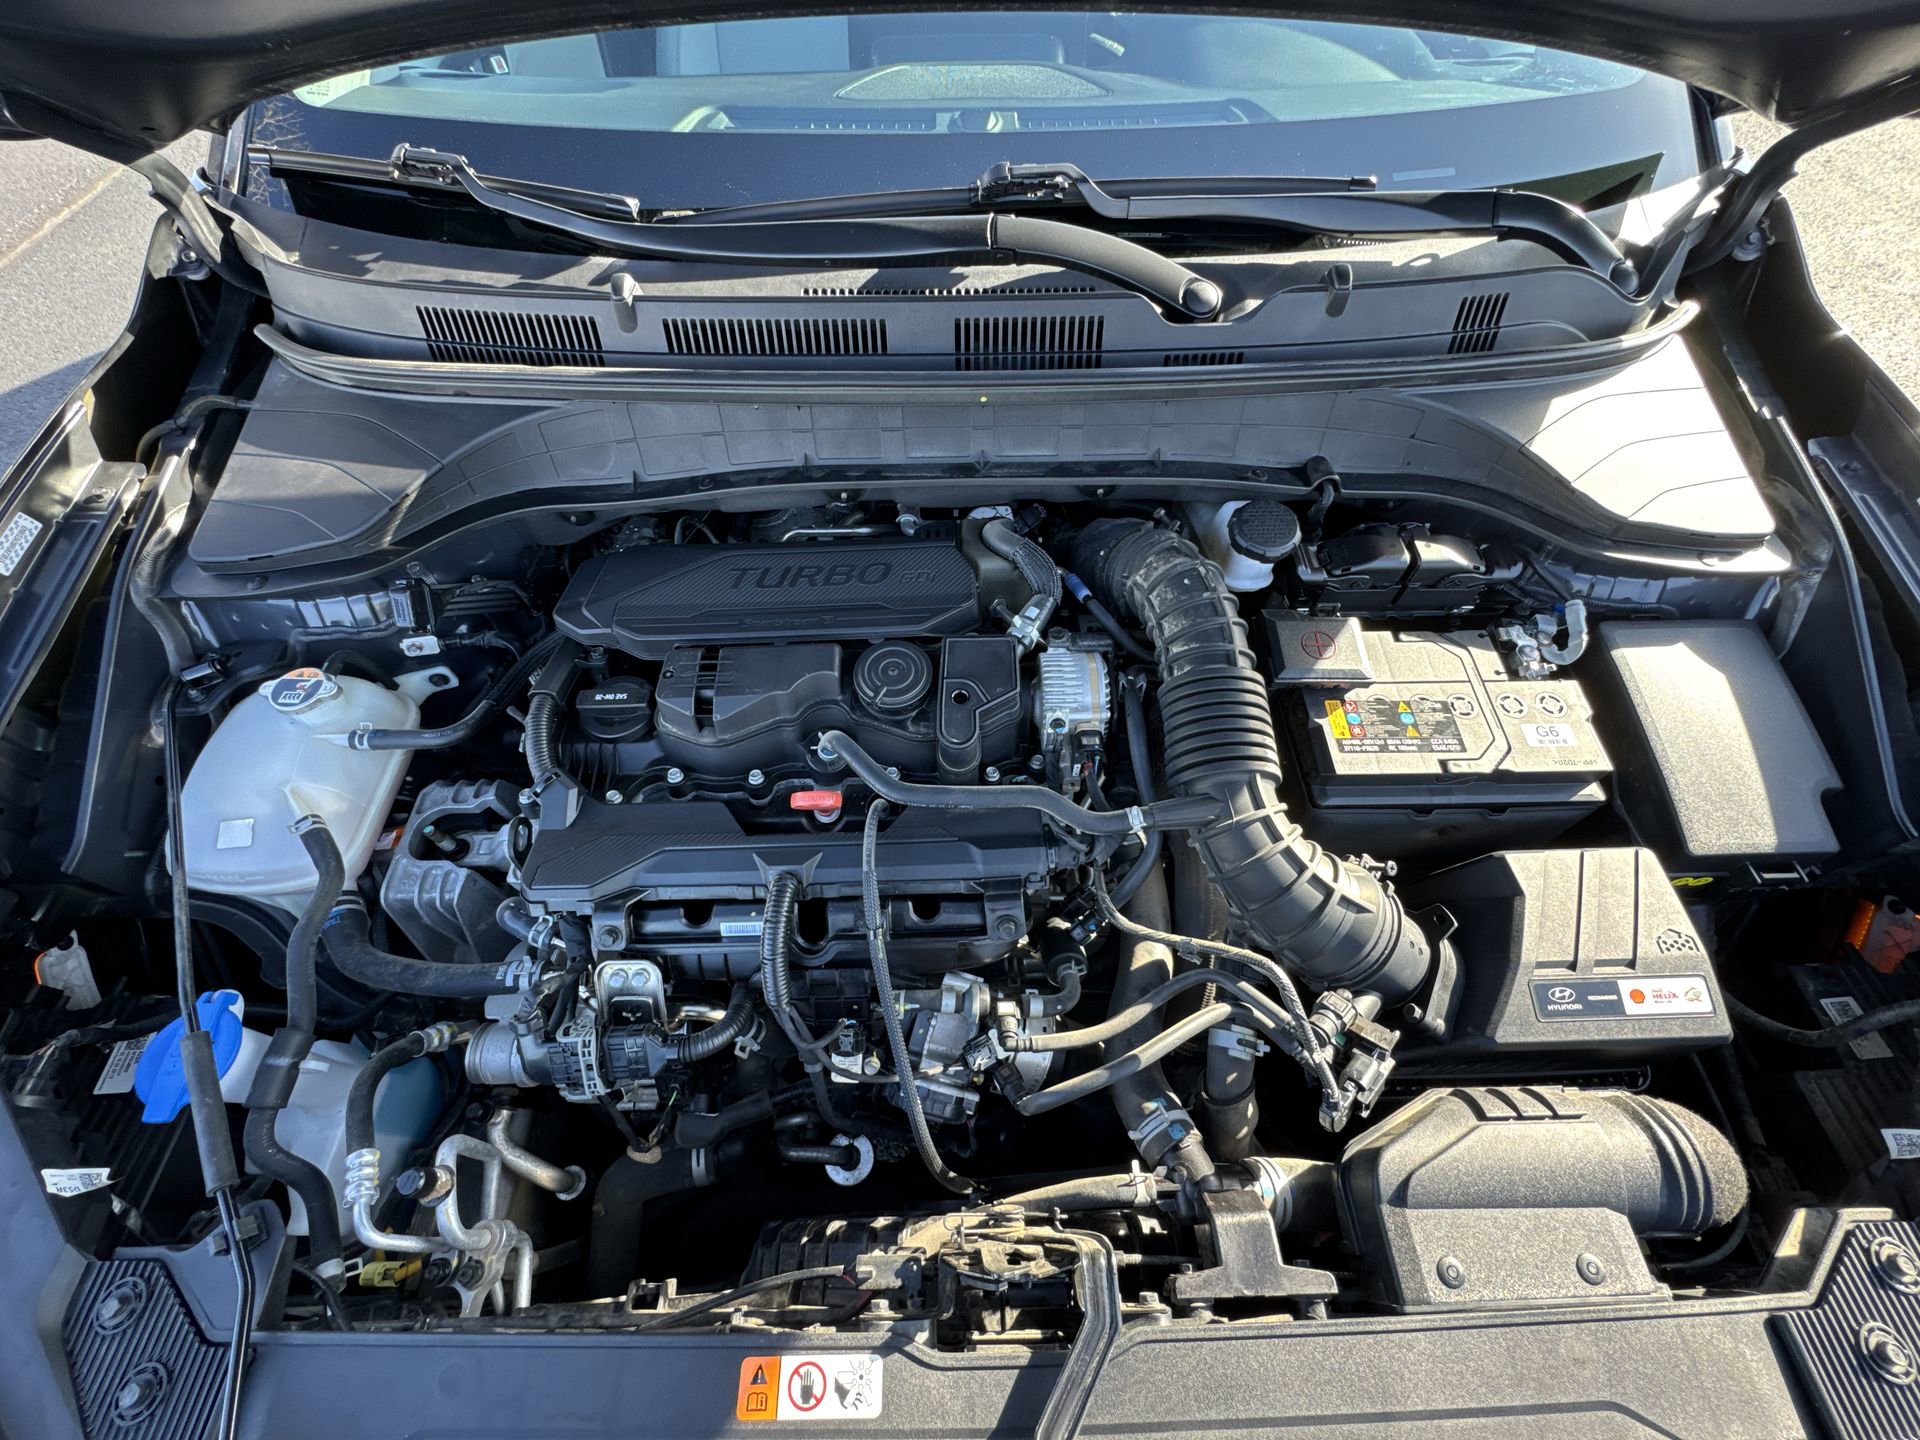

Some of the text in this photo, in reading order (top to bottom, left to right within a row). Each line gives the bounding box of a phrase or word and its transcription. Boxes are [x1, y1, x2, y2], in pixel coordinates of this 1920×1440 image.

[729, 562, 893, 590] TURBO
[1536, 725, 1560, 738] G6
[1652, 991, 1680, 999] HELIX
[1547, 1003, 1583, 1011] HYUNDAI
